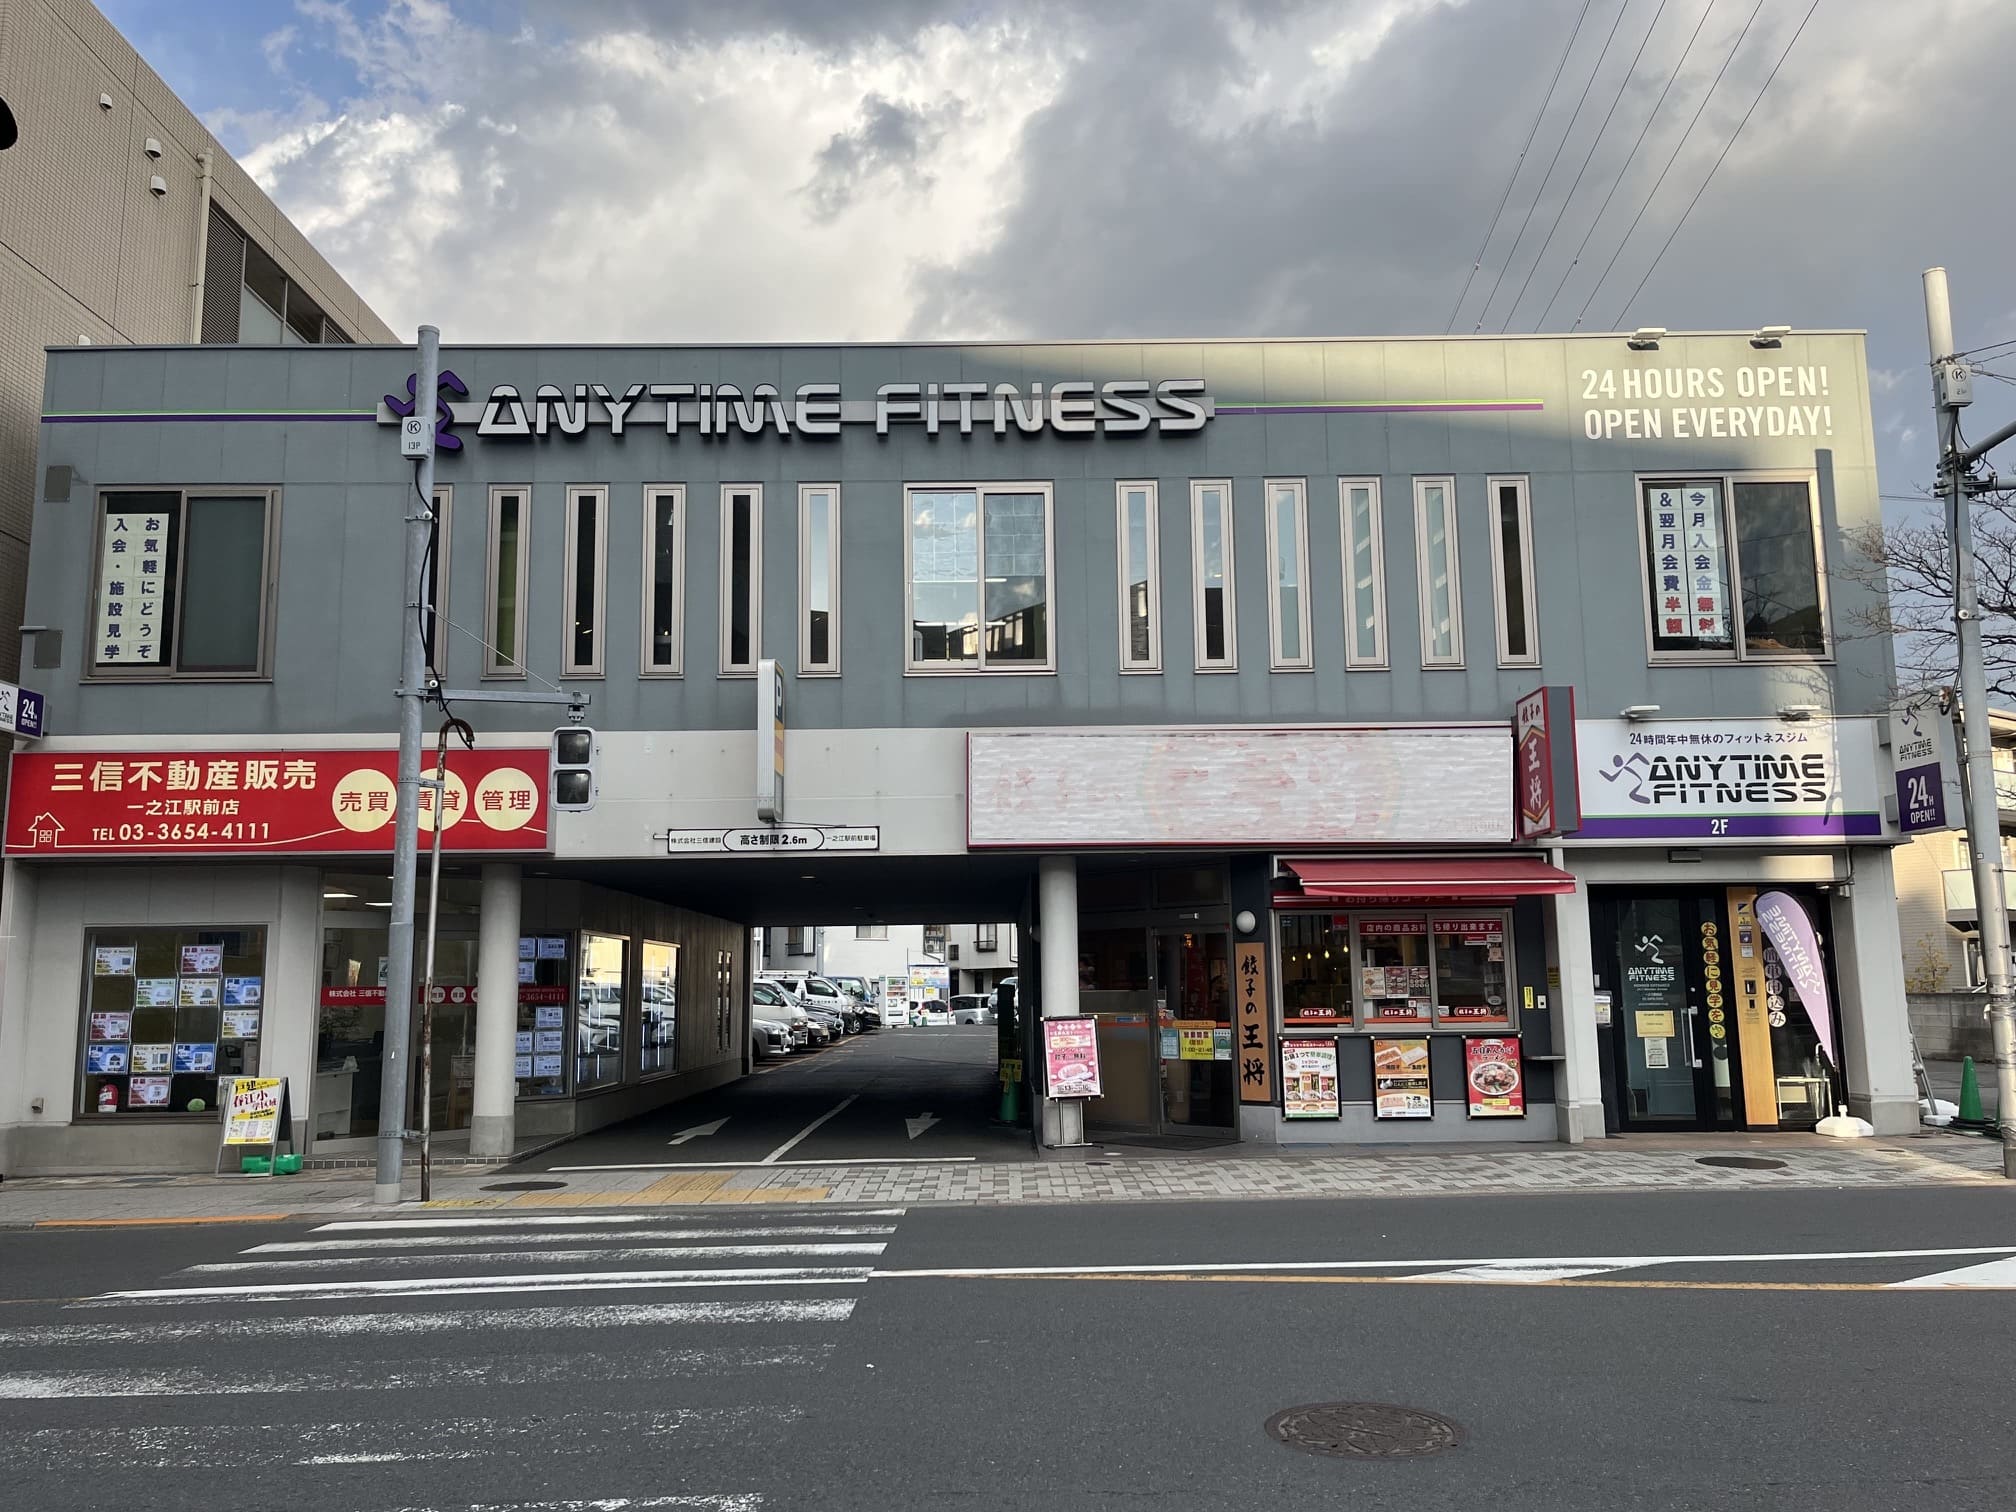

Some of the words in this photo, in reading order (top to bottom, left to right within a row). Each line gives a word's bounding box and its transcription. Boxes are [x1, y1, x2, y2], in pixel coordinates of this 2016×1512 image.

[1581, 369, 1617, 399] 24
[1623, 367, 1725, 399] HOURS
[1736, 365, 1829, 398] OPEN!
[476, 383, 841, 436] ANYTIME
[875, 379, 1207, 434] FITNESS
[1584, 408, 1663, 440] OPEN
[1672, 405, 1833, 438] EVERYDAY!
[1690, 491, 1715, 634] 今月入会金無料
[104, 517, 129, 659] 入会・施設見学
[137, 517, 160, 659] お気軽にどうぞ
[1630, 732, 1808, 746] 24時間年中無休のフィットネスジム
[1899, 739, 1932, 755] ANYTIME
[1900, 747, 1934, 762] FITNESS
[51, 759, 317, 793] 三信不動産販売
[1527, 738, 1543, 811] 王将
[1649, 753, 1825, 781] ANYTIME
[339, 791, 389, 812] 売買
[482, 790, 531, 811] 管理
[1654, 782, 1827, 804] FITNESS
[127, 799, 239, 816] 一之江駅前店
[1910, 808, 1936, 824] OPEN!!
[92, 827, 115, 842] TEL
[119, 822, 270, 841] 03-3654-4111
[1711, 819, 1728, 835] 2F
[740, 834, 780, 846] 高さ制限
[782, 834, 808, 846] 2.6m
[1627, 966, 1675, 975] ANYTIME
[1628, 974, 1675, 982] FITNESS
[1240, 954, 1266, 1087] 餃子の王将
